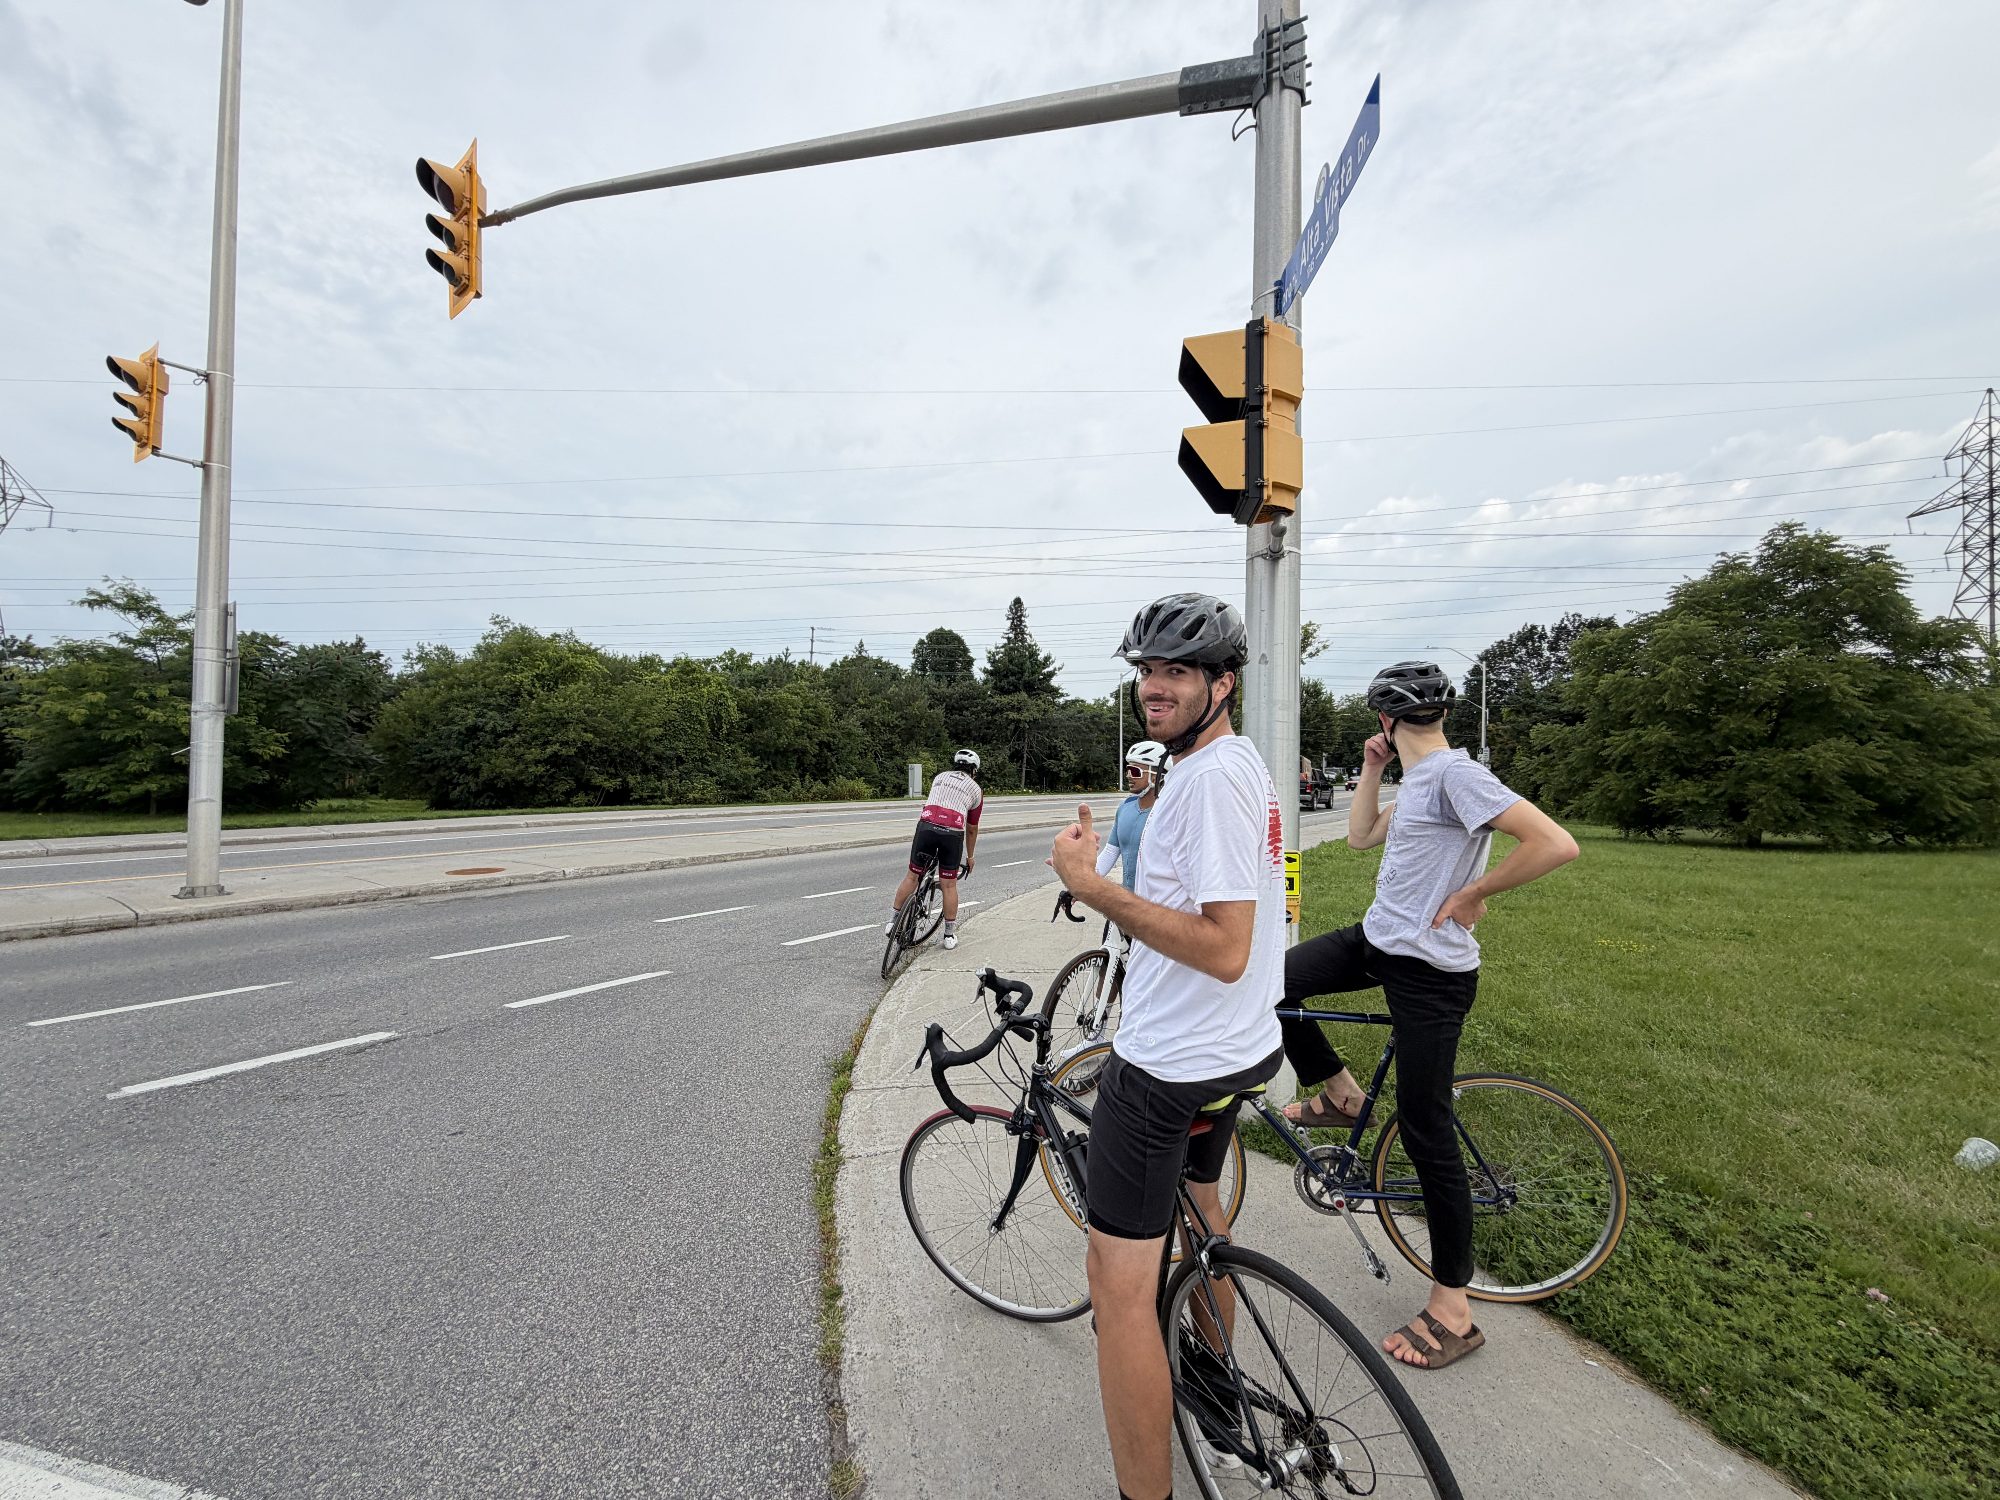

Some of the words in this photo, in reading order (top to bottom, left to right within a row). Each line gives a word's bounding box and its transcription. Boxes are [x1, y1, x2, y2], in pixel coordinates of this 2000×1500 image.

[1300, 220, 1320, 276] Alta
[1325, 155, 1353, 226] Vista
[1357, 131, 1370, 165] Dr.
